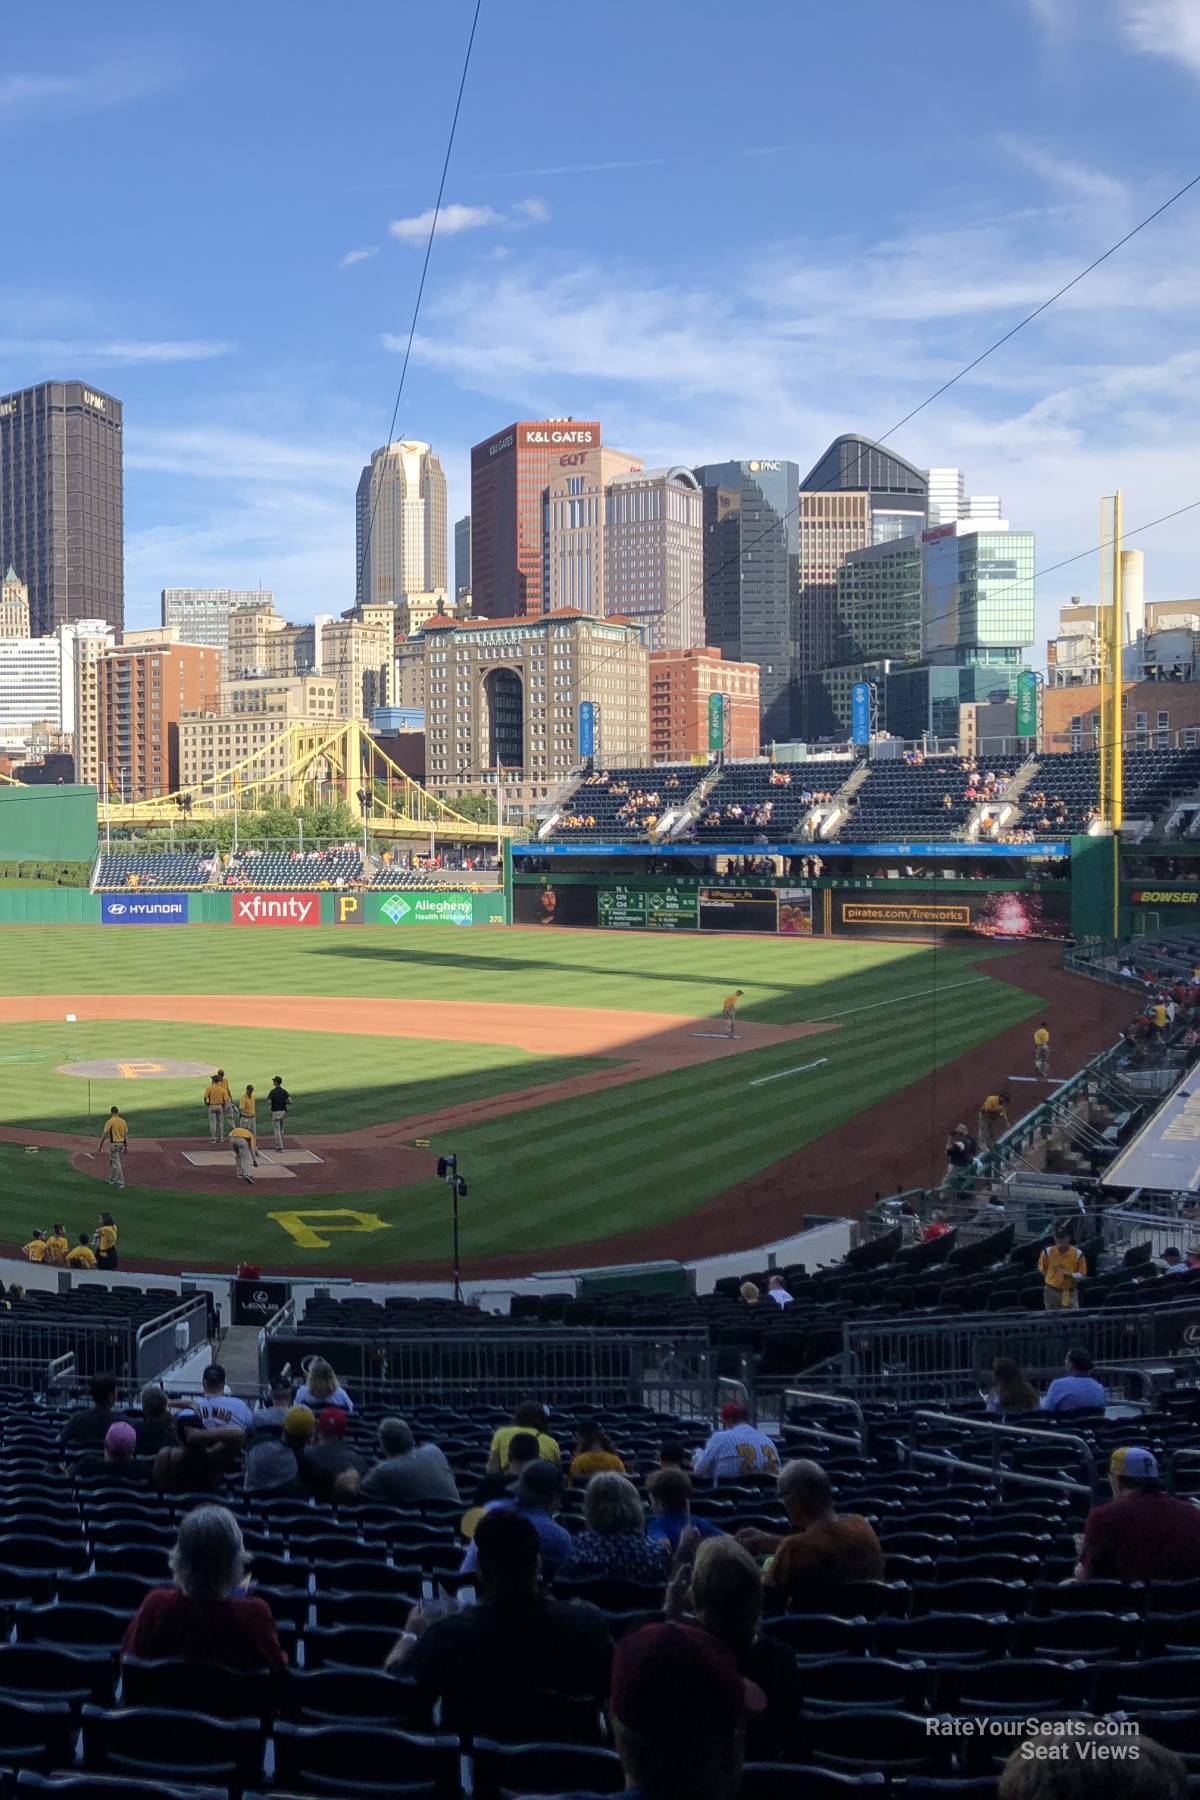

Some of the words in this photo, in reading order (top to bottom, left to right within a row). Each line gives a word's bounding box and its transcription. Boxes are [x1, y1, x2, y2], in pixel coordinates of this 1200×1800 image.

[83, 391, 106, 412] UPMC
[526, 431, 550, 443] K&L
[551, 431, 593, 443] GATES
[559, 451, 588, 467] EQT
[760, 462, 782, 471] PNC
[676, 877, 747, 887] WELCOME
[831, 880, 873, 888] PARK
[1141, 891, 1198, 904] BOWSER
[129, 904, 182, 914] HYUNDAI
[238, 896, 312, 922] xfinity
[339, 896, 358, 922] P
[415, 900, 472, 914] Allegheny
[415, 913, 438, 921] Health
[439, 913, 471, 922] Network
[489, 915, 504, 924] 375
[847, 908, 963, 921] pirates.com/fireworks
[266, 1208, 393, 1249] P
[241, 1302, 279, 1312] LEXUS
